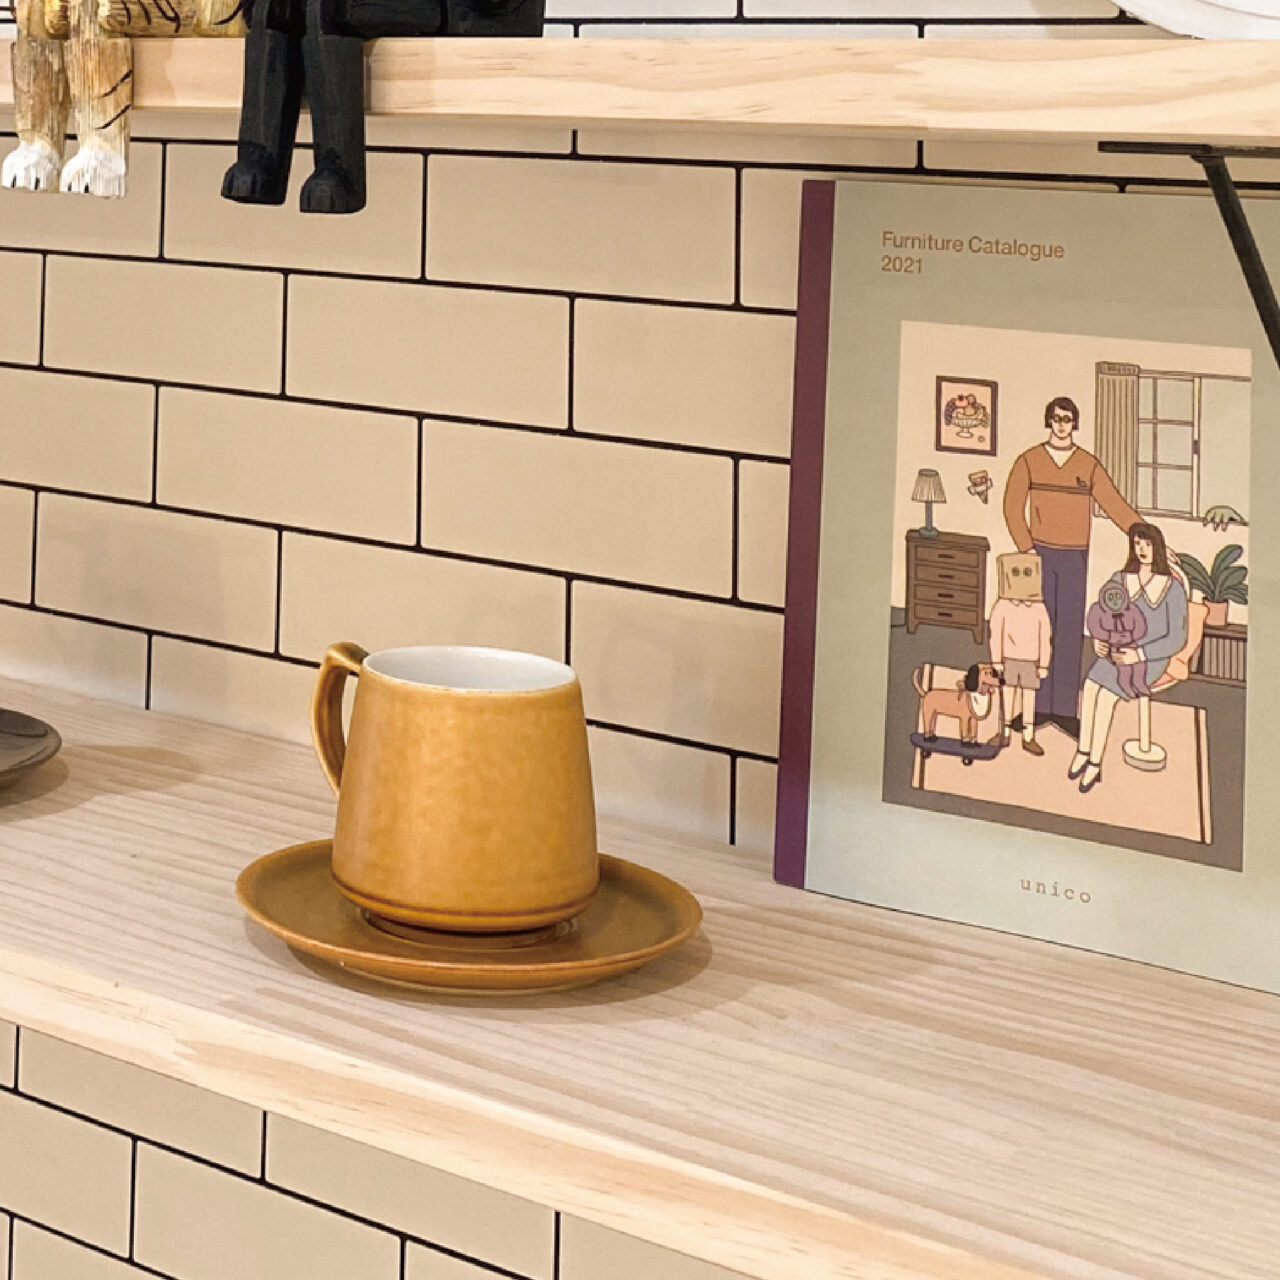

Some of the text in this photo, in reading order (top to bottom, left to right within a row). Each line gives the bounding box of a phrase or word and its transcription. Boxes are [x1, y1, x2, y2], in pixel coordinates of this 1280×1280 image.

[881, 230, 1065, 262] Furniture Catalogue
[881, 254, 924, 274] 2021
[1020, 878, 1091, 903] unico
